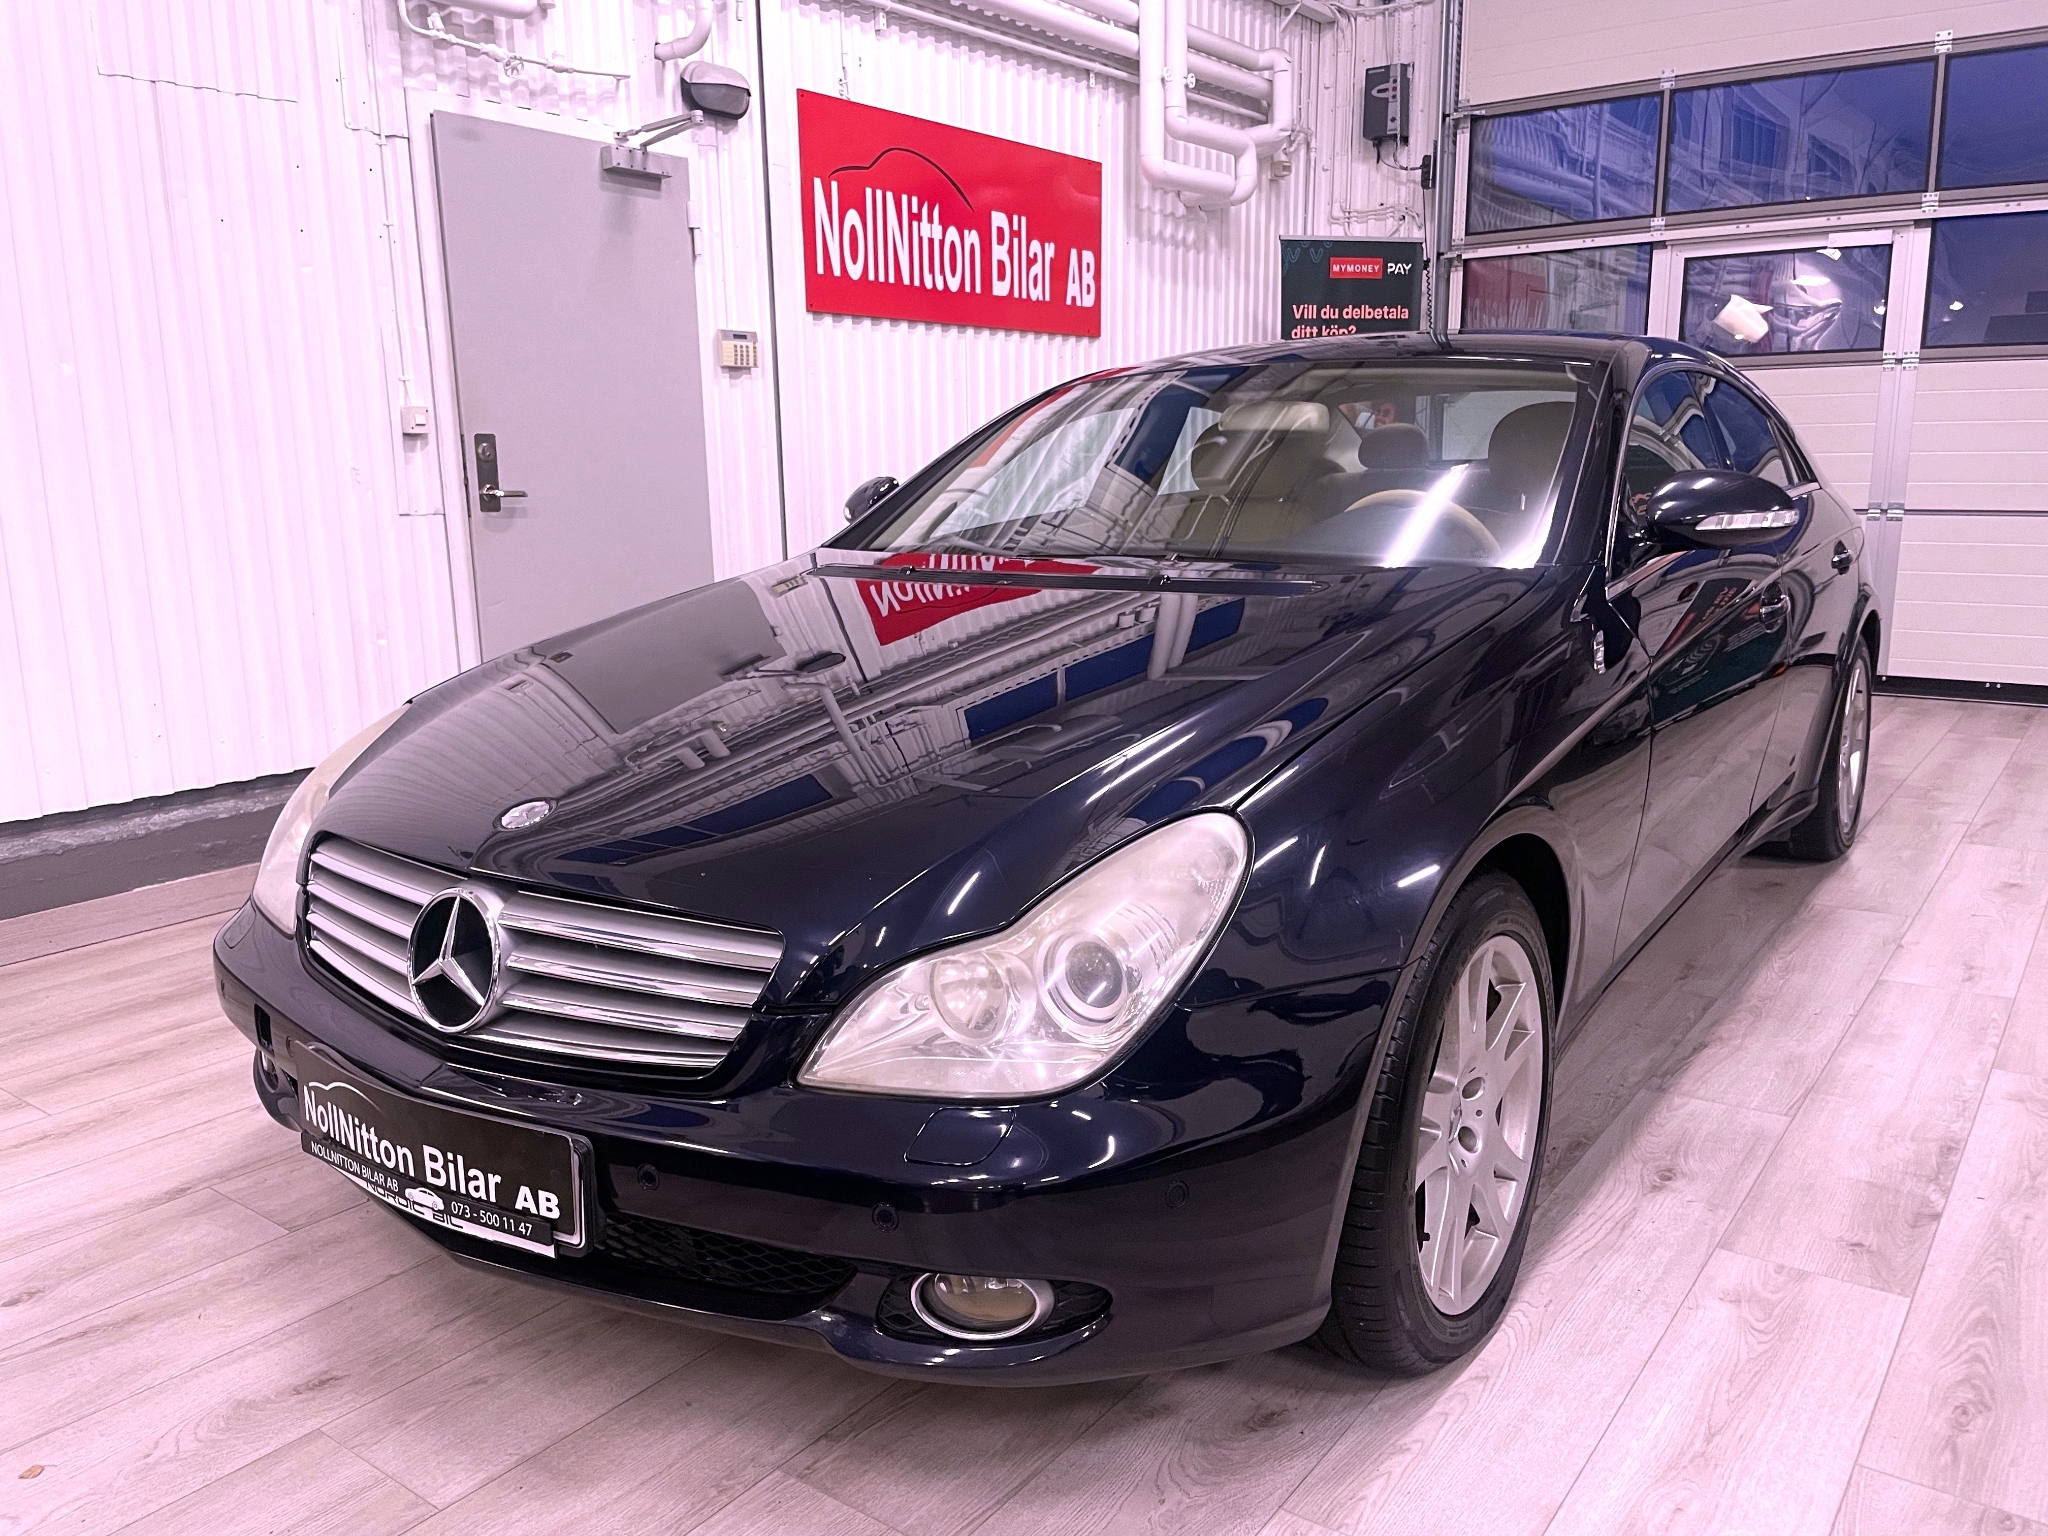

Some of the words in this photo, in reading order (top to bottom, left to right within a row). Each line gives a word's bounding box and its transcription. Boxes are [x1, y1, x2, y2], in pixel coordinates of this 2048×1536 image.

[813, 176, 982, 295] NollNitton
[990, 210, 1055, 302] Bilar
[1065, 247, 1097, 308] AB
[1332, 264, 1380, 273] MYMONEY
[1387, 263, 1412, 275] PAY
[1292, 304, 1318, 319] Vill
[1320, 304, 1339, 319] du
[1342, 304, 1409, 319] delbetala
[1291, 325, 1319, 339] ditt
[303, 1085, 414, 1177] NollNitton
[423, 1144, 501, 1203] Bilar
[515, 1185, 561, 1219] AB
[311, 1140, 361, 1175] NOLLNITTON
[361, 1164, 386, 1187] BILAR
[386, 1177, 400, 1193] AB
[451, 1201, 471, 1218] 073
[480, 1210, 500, 1227] 500
[502, 1217, 515, 1232] 11
[518, 1222, 532, 1236] 47
